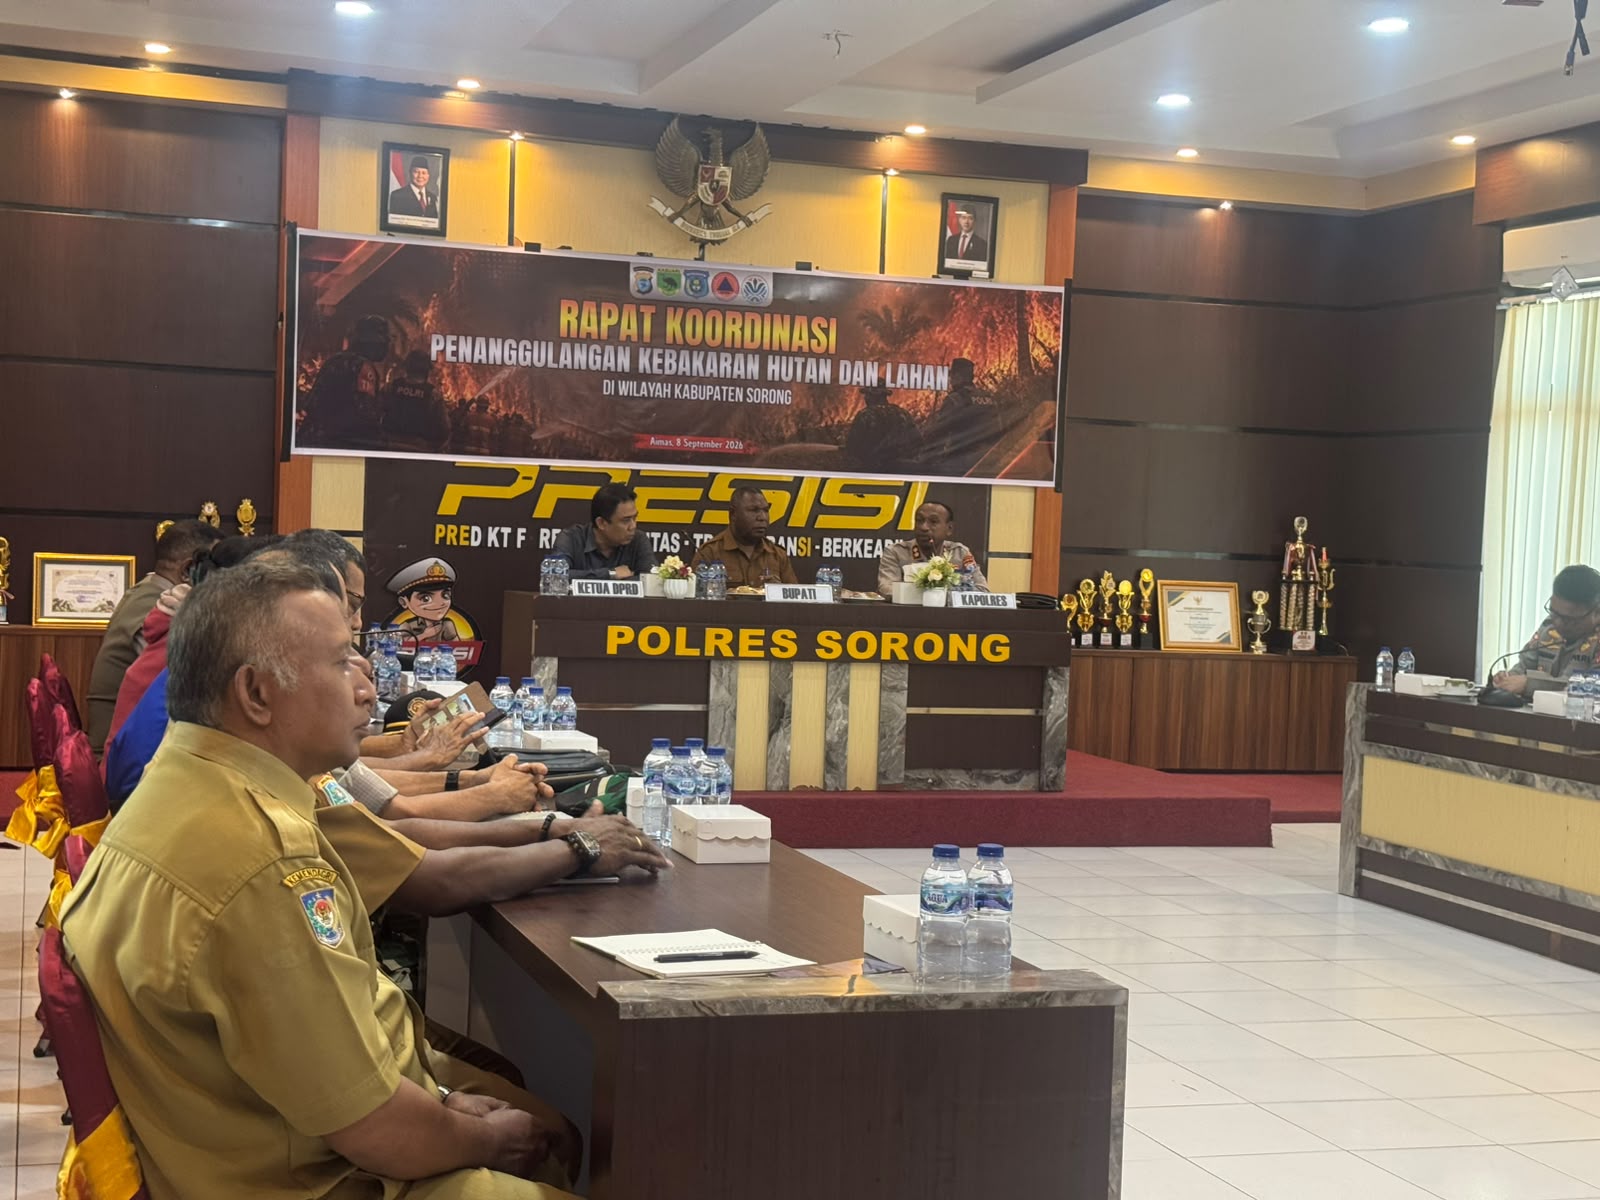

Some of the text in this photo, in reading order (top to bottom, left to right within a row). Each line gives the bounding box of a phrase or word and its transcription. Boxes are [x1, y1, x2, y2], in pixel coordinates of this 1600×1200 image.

[560, 299, 837, 354] RAPAT KOORDINASI
[431, 333, 949, 391] PENANGGULANGAN KEBAKARAN HUTAN DAN LAHAN
[603, 379, 792, 405] DI WILAYAH KABUPATEN SORONG
[676, 438, 681, 447] 8
[683, 438, 722, 449] September
[725, 441, 743, 449] 2026
[577, 582, 639, 596] KETUA DPRD
[782, 588, 817, 600] BUPATI
[961, 594, 1008, 607] KAPOLRES
[606, 625, 1011, 663] POLRES SORONG
